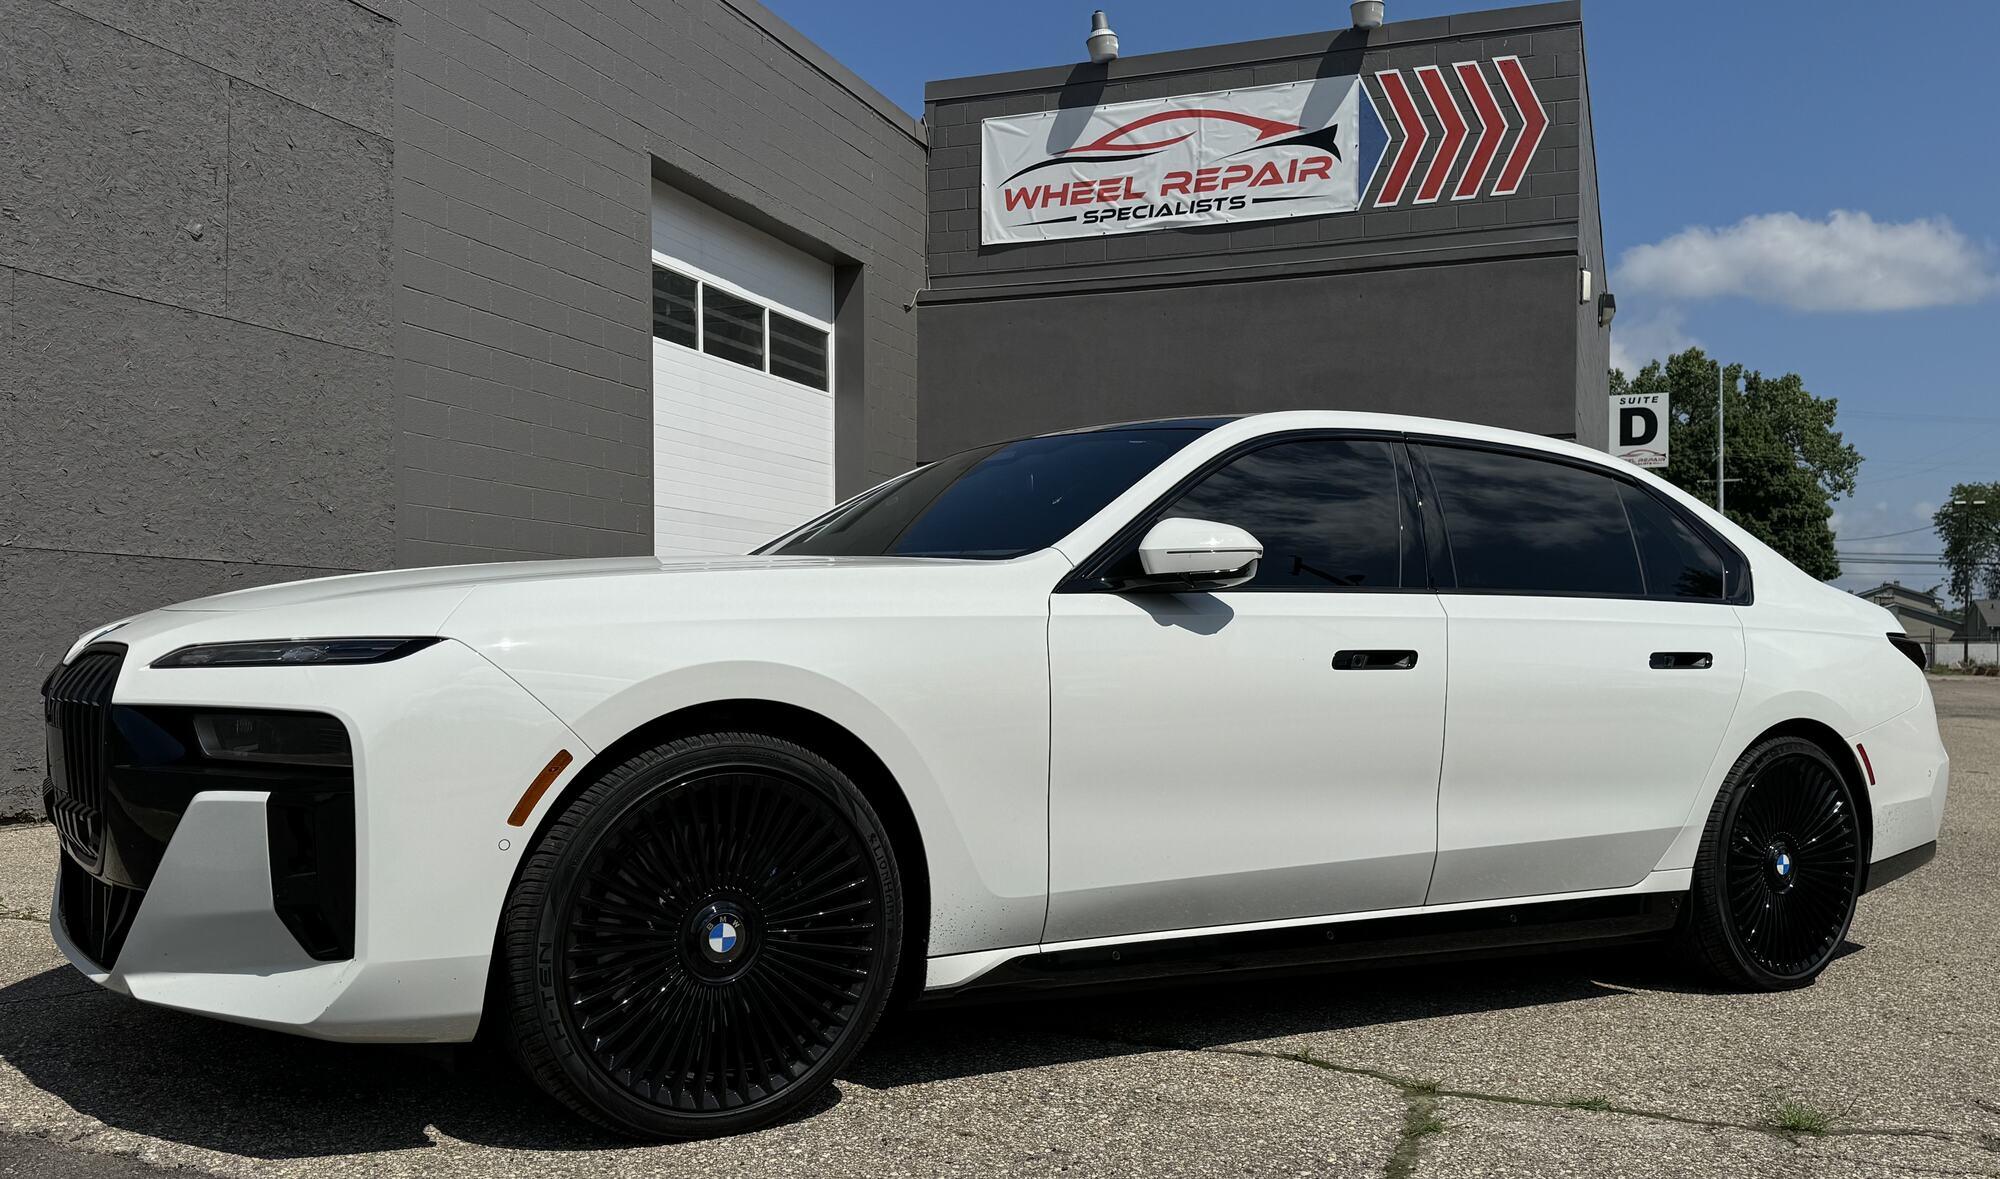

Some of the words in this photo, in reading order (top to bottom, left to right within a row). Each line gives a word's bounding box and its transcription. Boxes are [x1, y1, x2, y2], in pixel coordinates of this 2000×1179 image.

[1004, 176, 1146, 212] WHEEL
[1160, 155, 1333, 196] REPAIR
[1082, 195, 1246, 225] SPECIALISTS
[1620, 396, 1659, 405] SUITE
[1619, 407, 1658, 446] D
[705, 915, 741, 931] BMW
